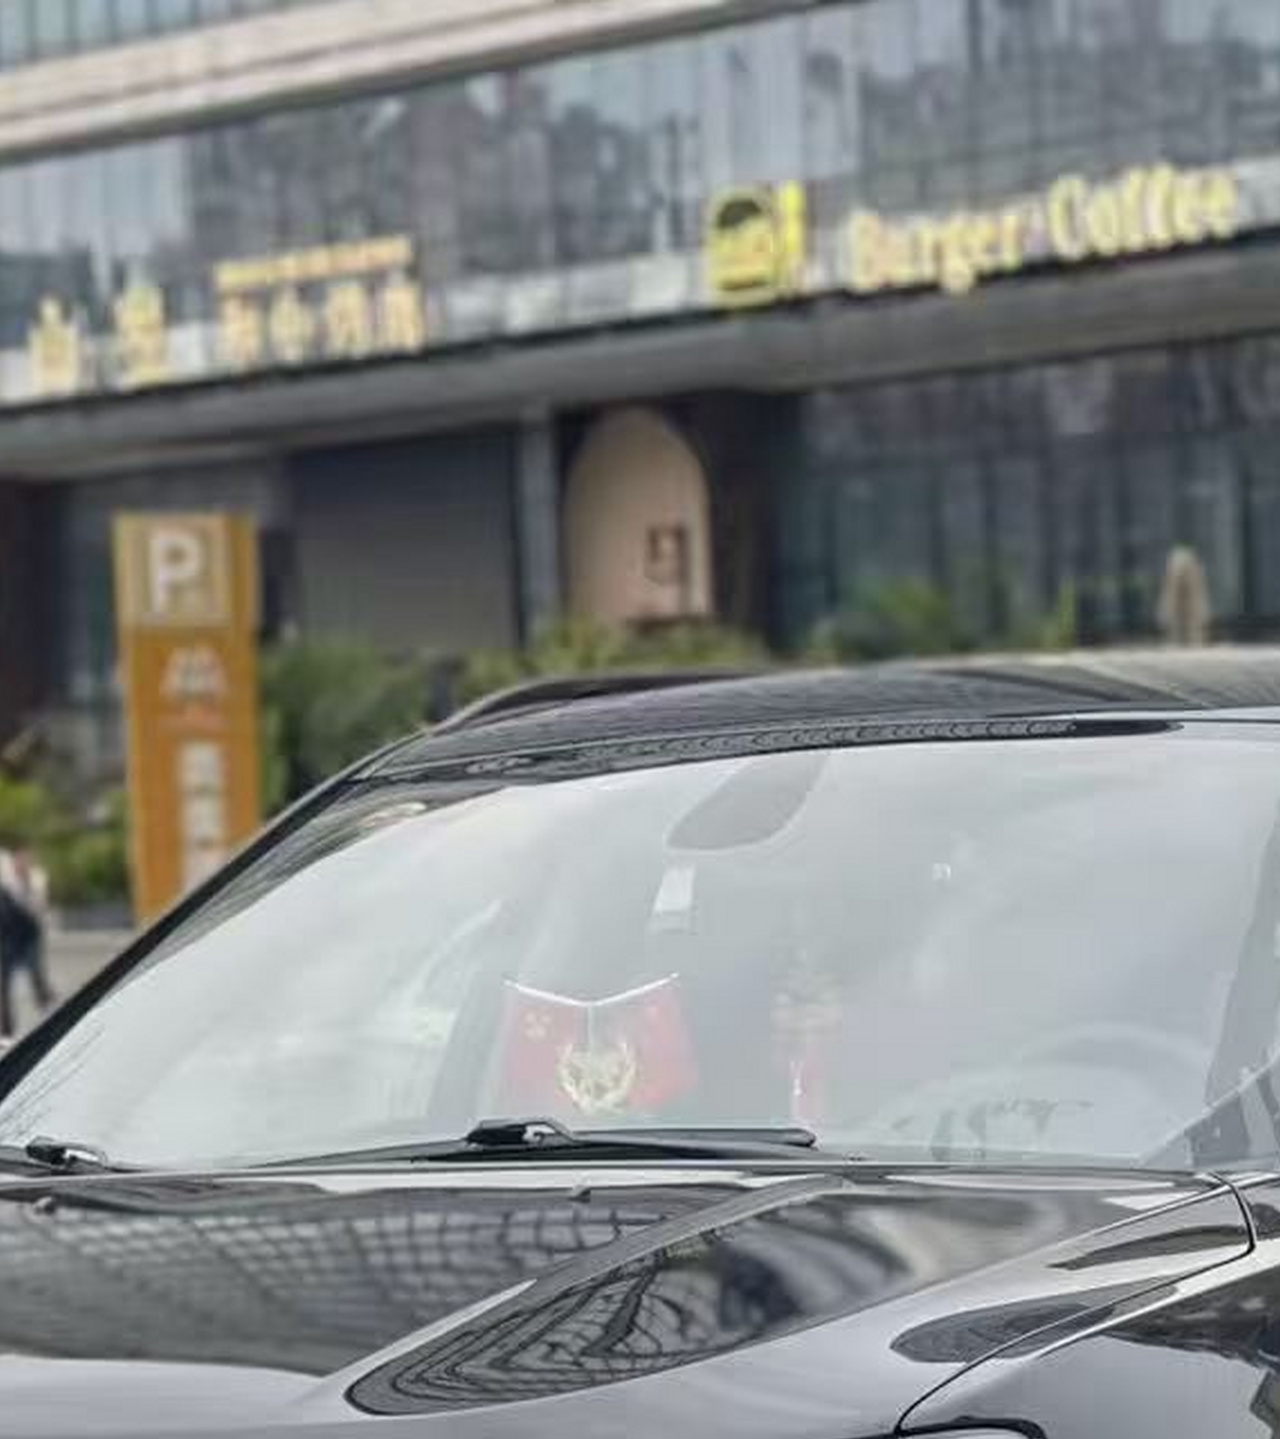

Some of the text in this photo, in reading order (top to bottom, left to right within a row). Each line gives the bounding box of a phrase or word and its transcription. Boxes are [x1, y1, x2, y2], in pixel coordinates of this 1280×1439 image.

[851, 165, 1237, 295] Burger Coffee
[148, 527, 205, 614] P
